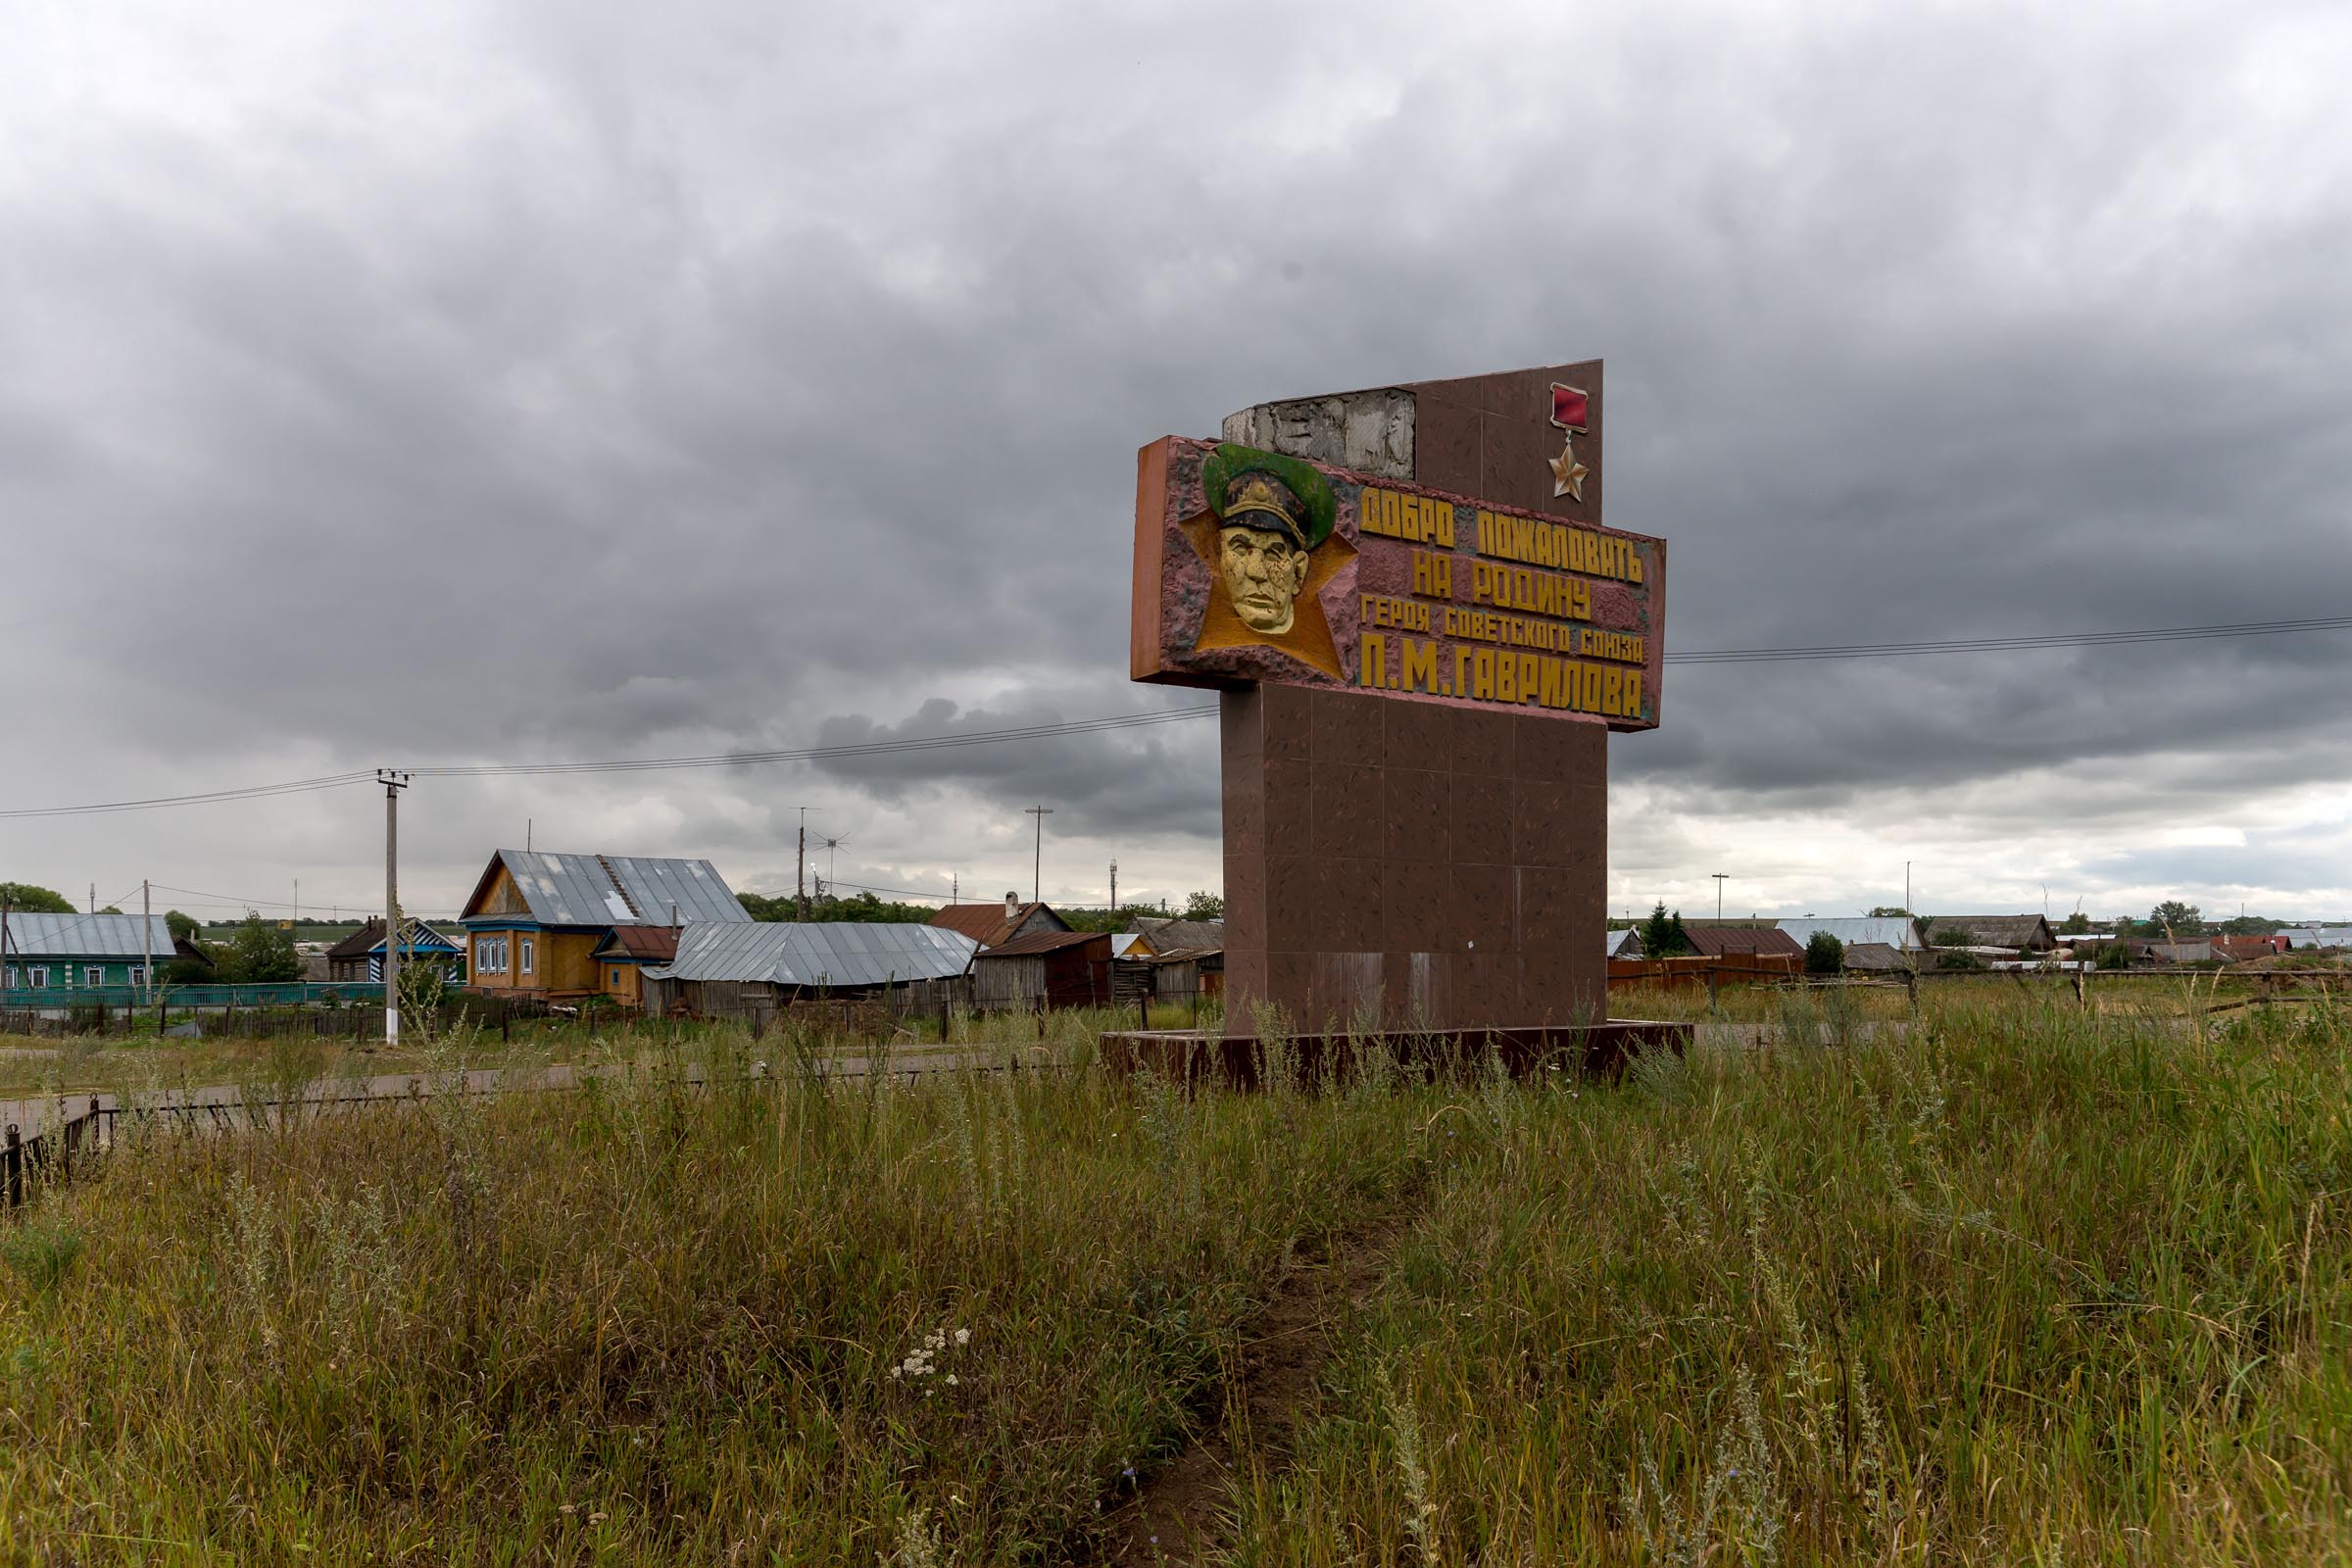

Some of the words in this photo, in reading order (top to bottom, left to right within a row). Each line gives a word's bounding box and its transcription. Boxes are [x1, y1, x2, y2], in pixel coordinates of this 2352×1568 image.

[1359, 487, 1454, 549] ДОБРО
[1477, 511, 1643, 584] ПОЖАЛОВАТЬ
[1412, 551, 1451, 599] НА
[1472, 561, 1591, 621] РОДИНУ
[1360, 594, 1430, 632] ГЕРОЯ
[1445, 609, 1570, 653] СОВЕТСКОГО
[1581, 629, 1643, 664] СОЮЗА
